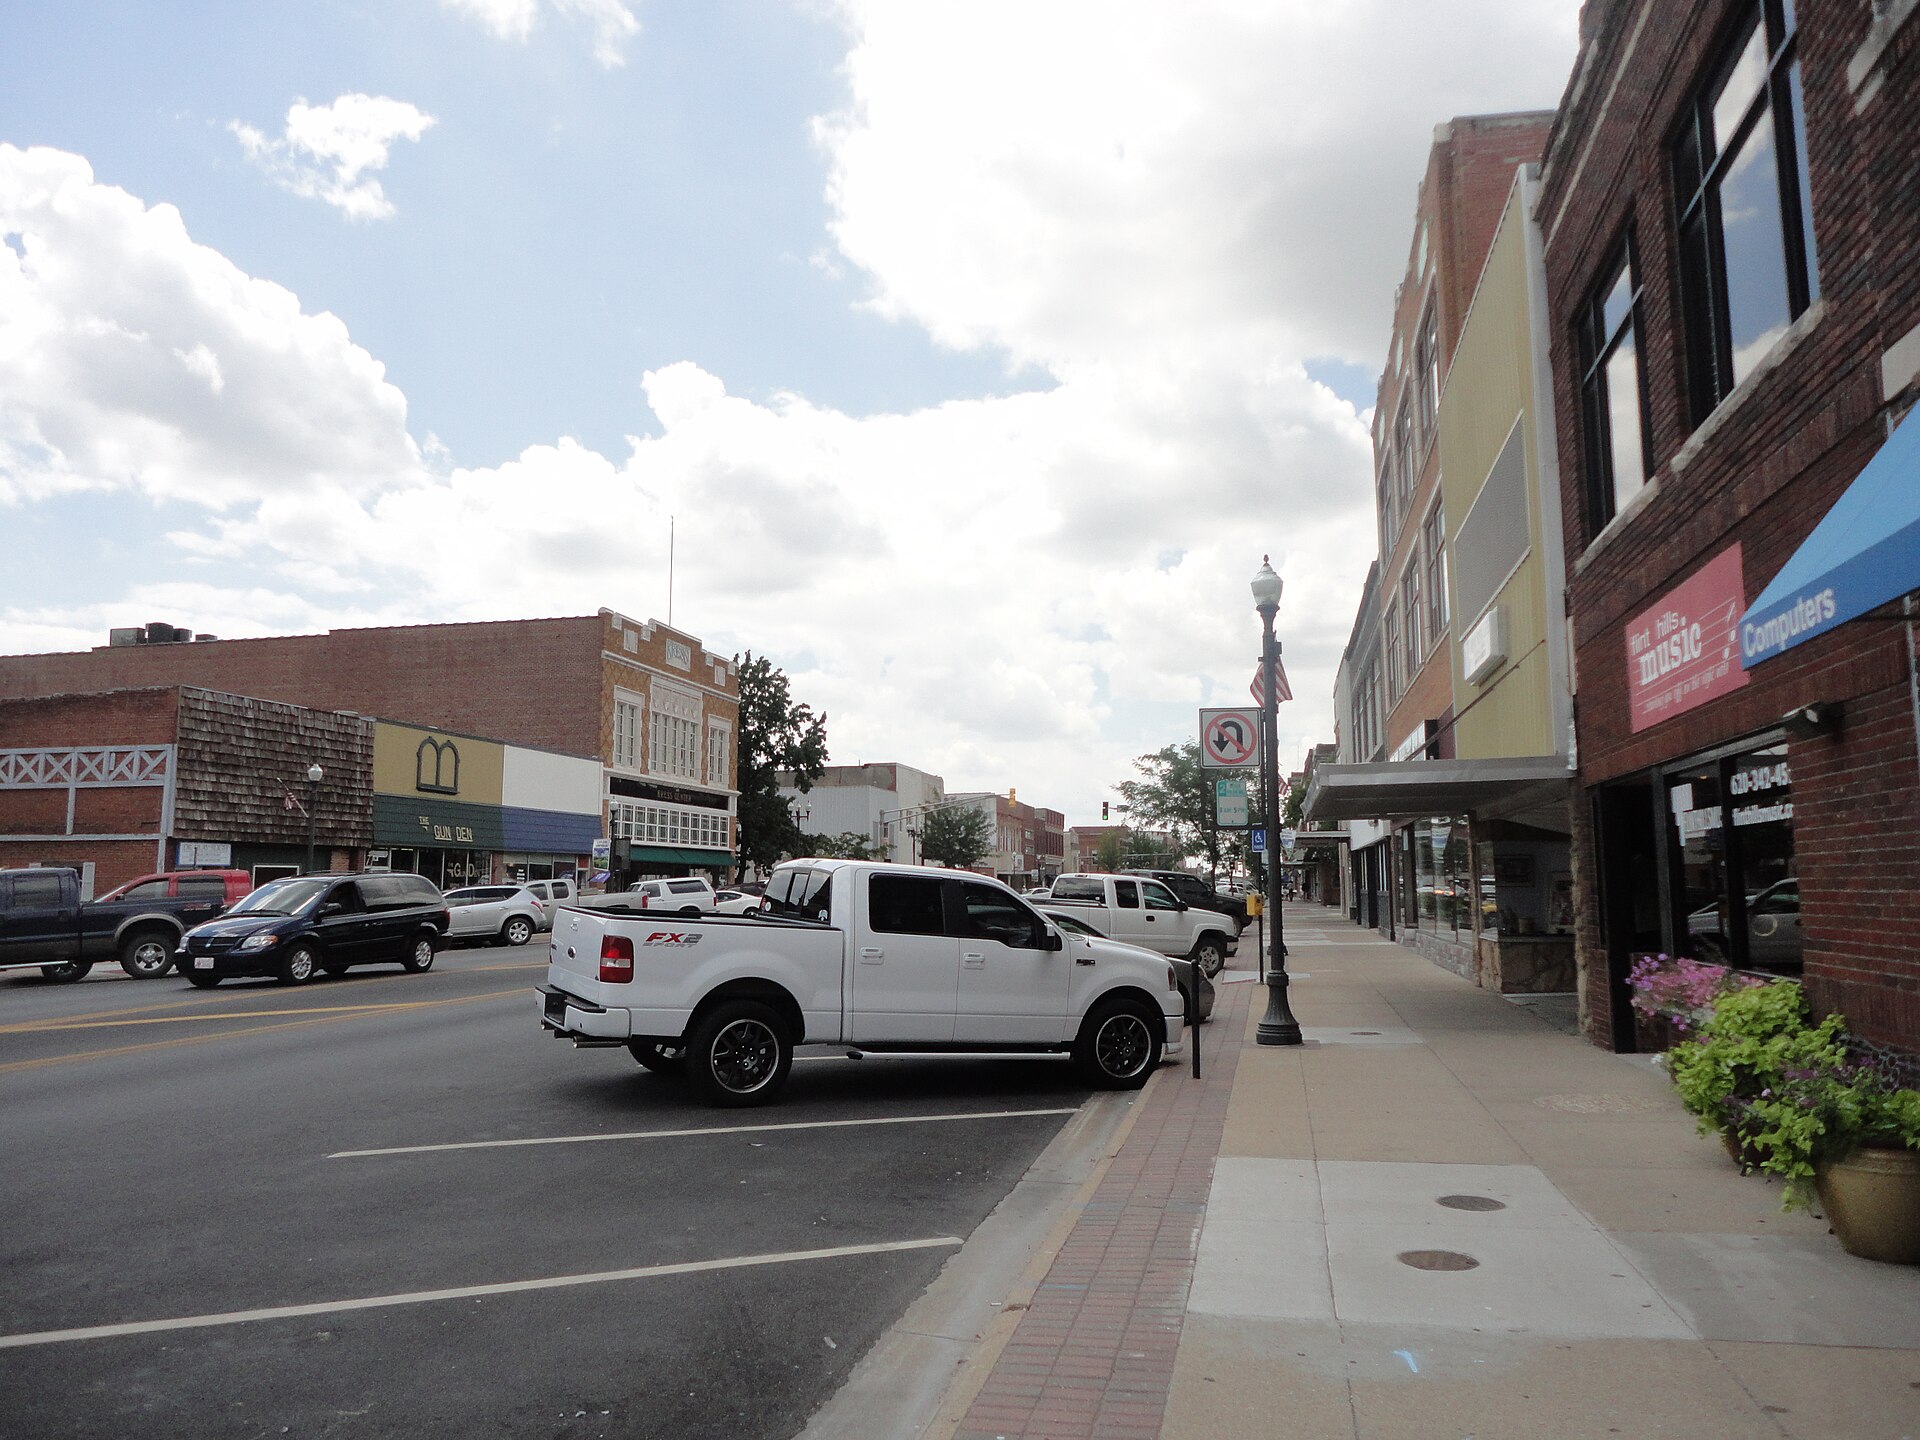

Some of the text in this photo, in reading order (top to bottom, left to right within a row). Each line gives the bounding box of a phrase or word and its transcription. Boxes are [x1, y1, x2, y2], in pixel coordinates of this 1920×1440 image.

[1632, 611, 1679, 656] flint hills
[1743, 588, 1836, 658] Computers
[1640, 616, 1702, 686] music
[1731, 762, 1792, 795] 620-342-45
[434, 825, 473, 841] GUN DEN
[645, 932, 703, 943] FX2
